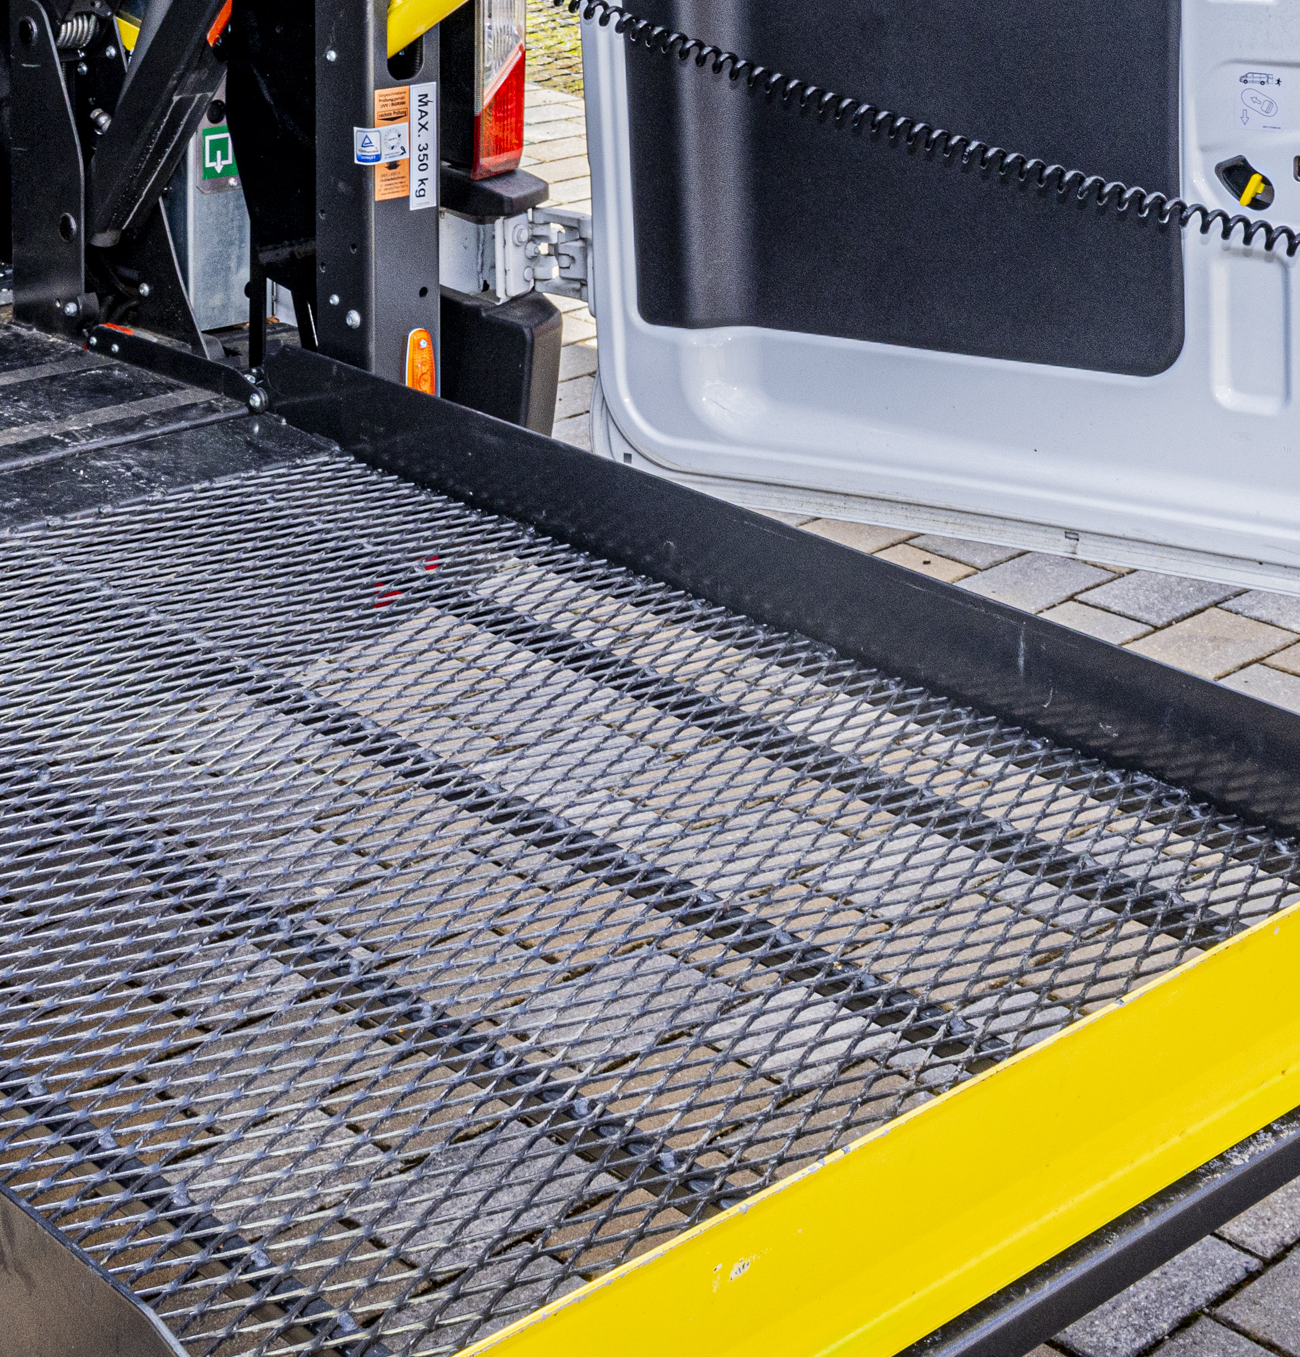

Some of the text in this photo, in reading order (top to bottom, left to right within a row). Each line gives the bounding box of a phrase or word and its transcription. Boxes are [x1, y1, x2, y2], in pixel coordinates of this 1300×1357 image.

[417, 93, 429, 137] MAX.
[417, 143, 429, 172] 350
[415, 177, 429, 198] kg
